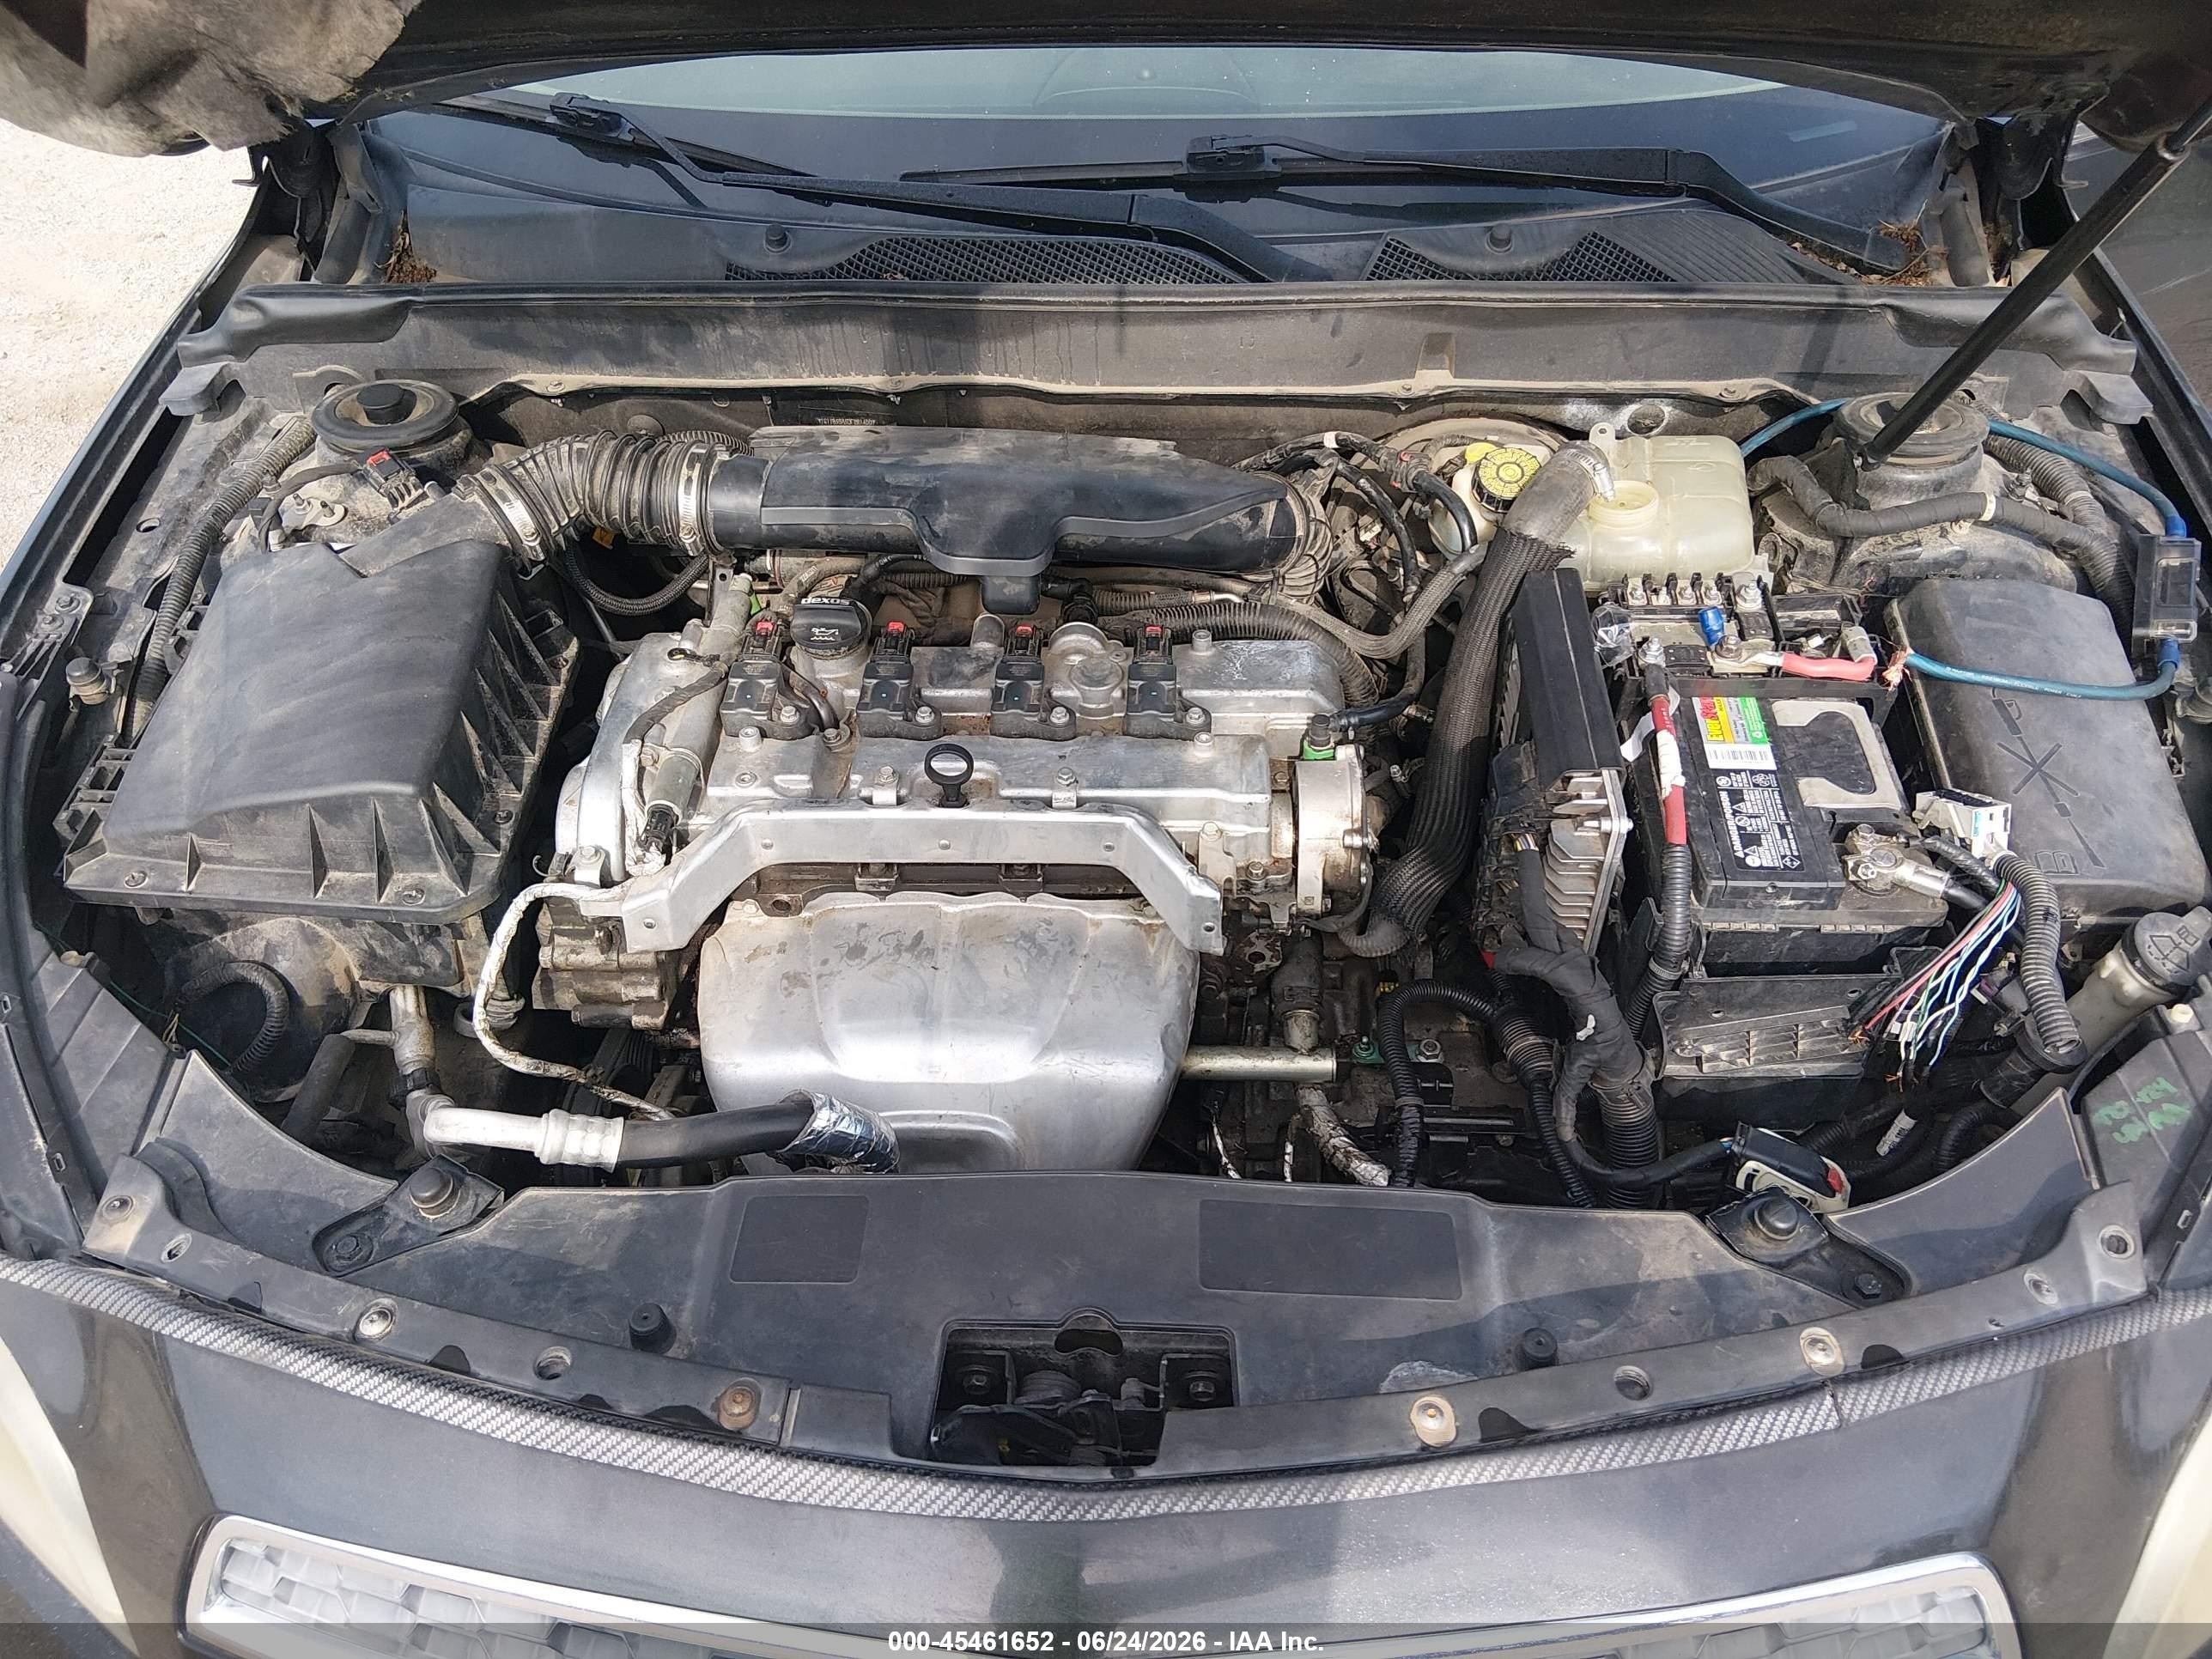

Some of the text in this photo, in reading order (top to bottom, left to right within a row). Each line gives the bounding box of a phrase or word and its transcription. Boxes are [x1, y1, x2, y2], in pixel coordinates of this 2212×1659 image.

[801, 596, 850, 605] dexos
[1699, 696, 1725, 741] EverStar
[1719, 790, 1742, 850] DANGER/POISON
